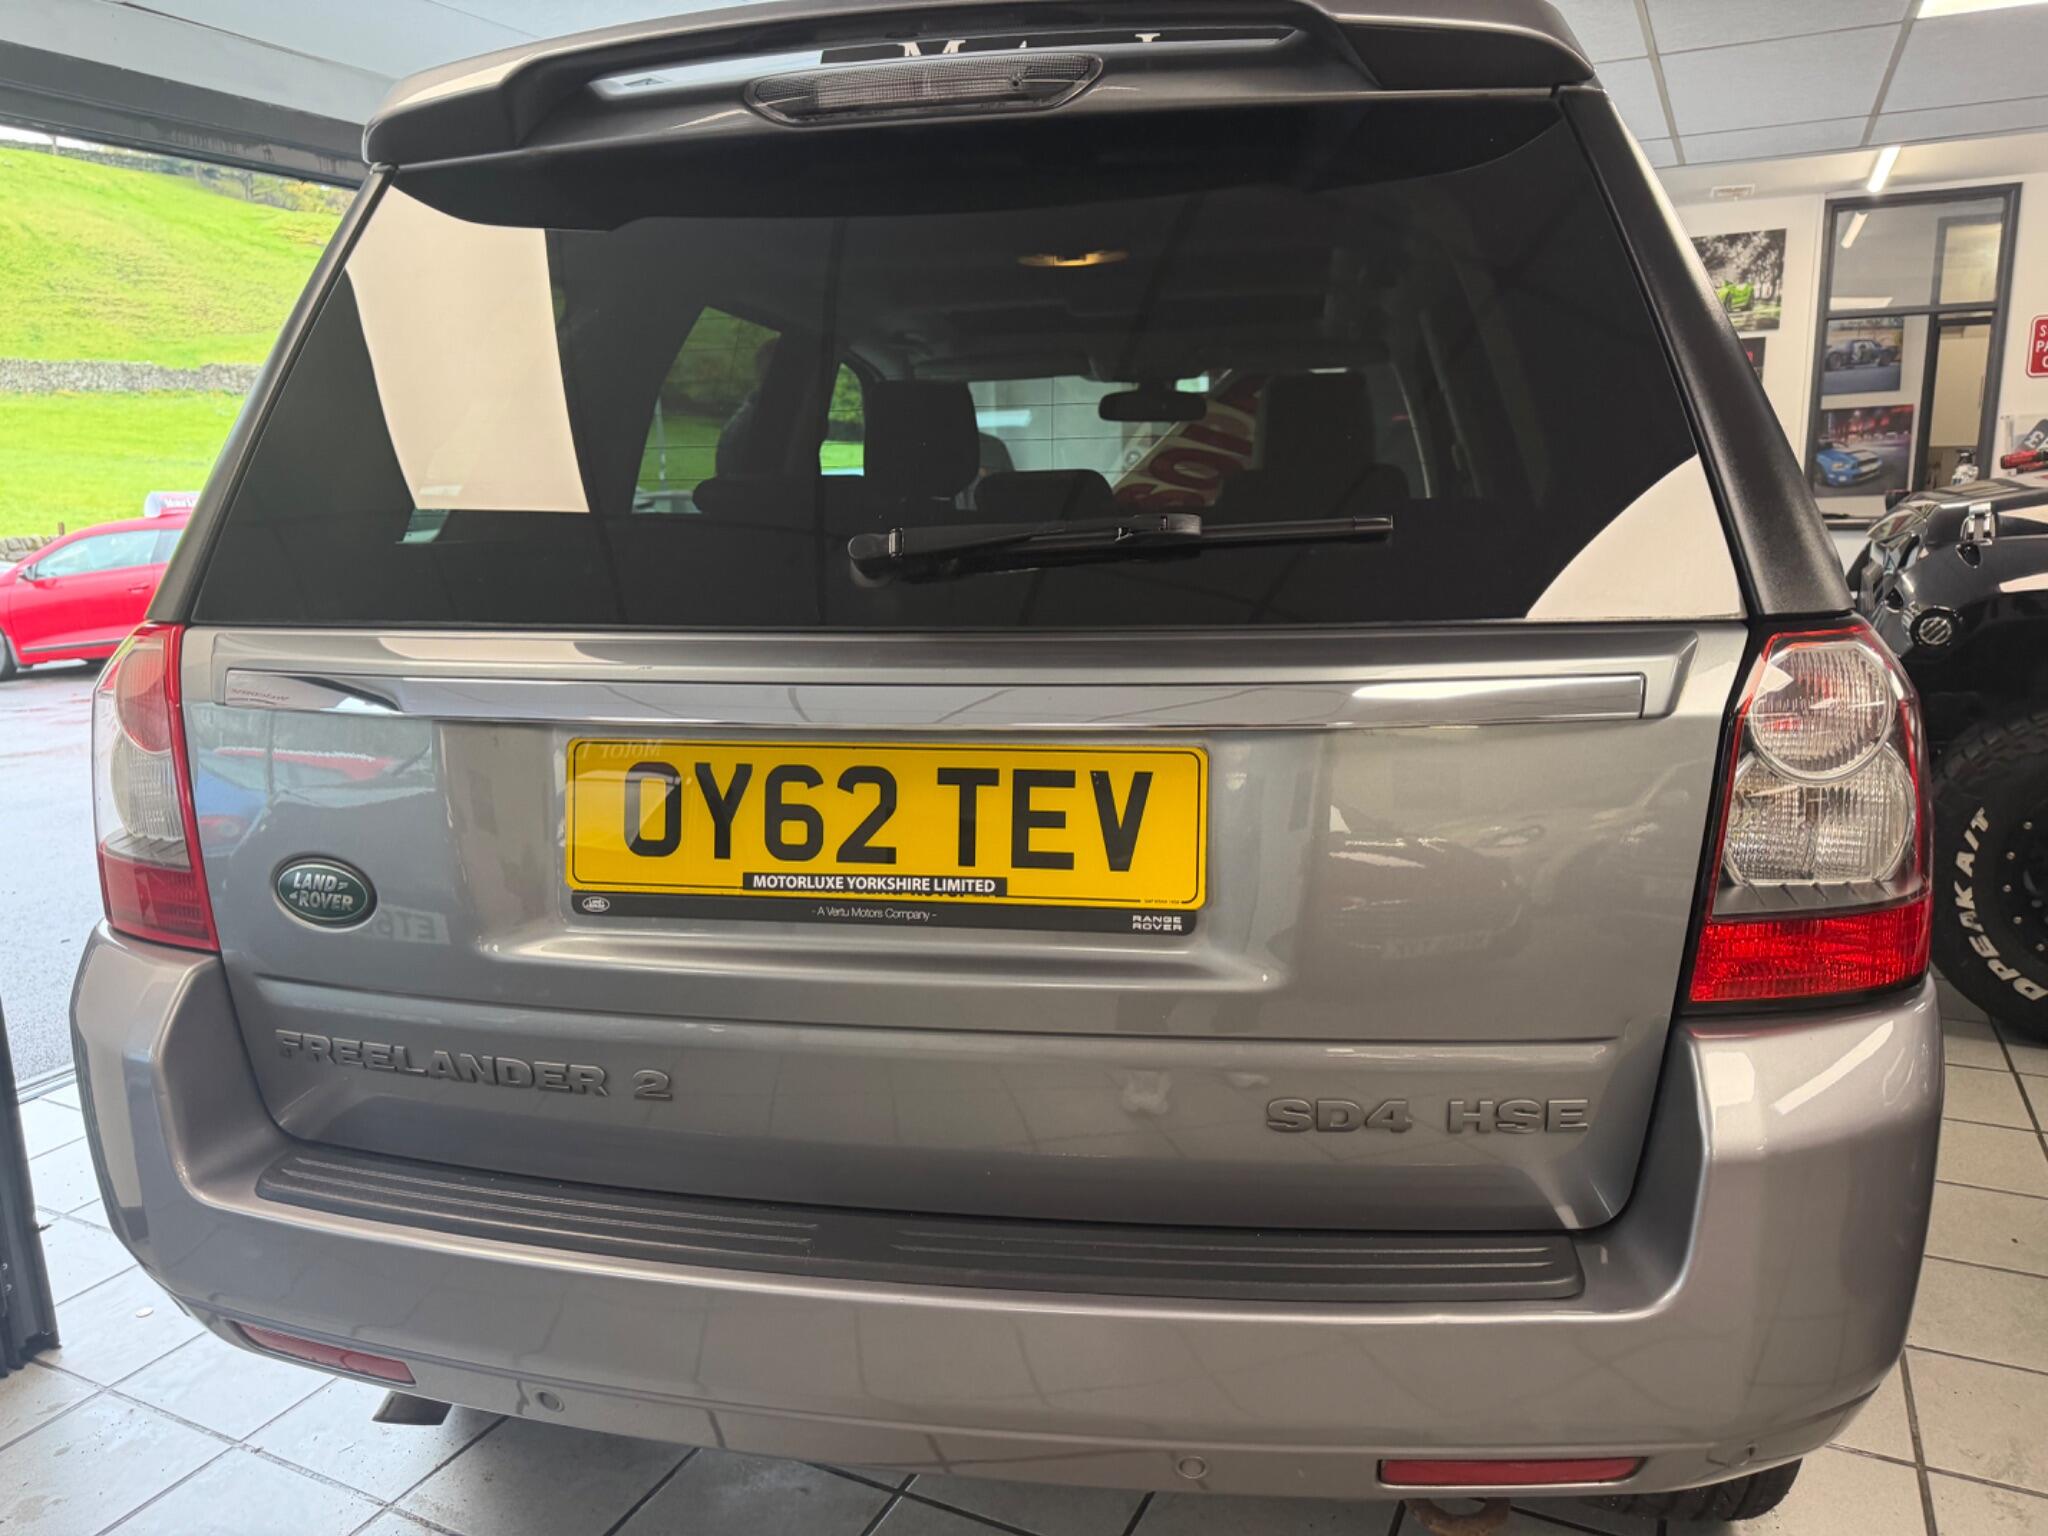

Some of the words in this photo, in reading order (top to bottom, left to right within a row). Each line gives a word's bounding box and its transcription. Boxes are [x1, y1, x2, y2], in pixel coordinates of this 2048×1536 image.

[624, 761, 897, 864] OY62
[937, 767, 1153, 872] TEV
[293, 871, 337, 892] LAND
[753, 875, 844, 890] MOTORLUXE
[847, 877, 931, 892] YORKSHIRE
[934, 879, 996, 893] LIMITED
[299, 889, 353, 911] ROVER
[827, 906, 850, 917] Vertu
[851, 908, 883, 918] Motors
[885, 909, 930, 922] Company
[1132, 915, 1182, 924] RANGE
[1132, 922, 1183, 932] ROVER
[275, 1029, 608, 1096] FREELANDER
[632, 1069, 672, 1100] 2
[1266, 1098, 1412, 1133] SD4
[1447, 1098, 1588, 1134] HSE
